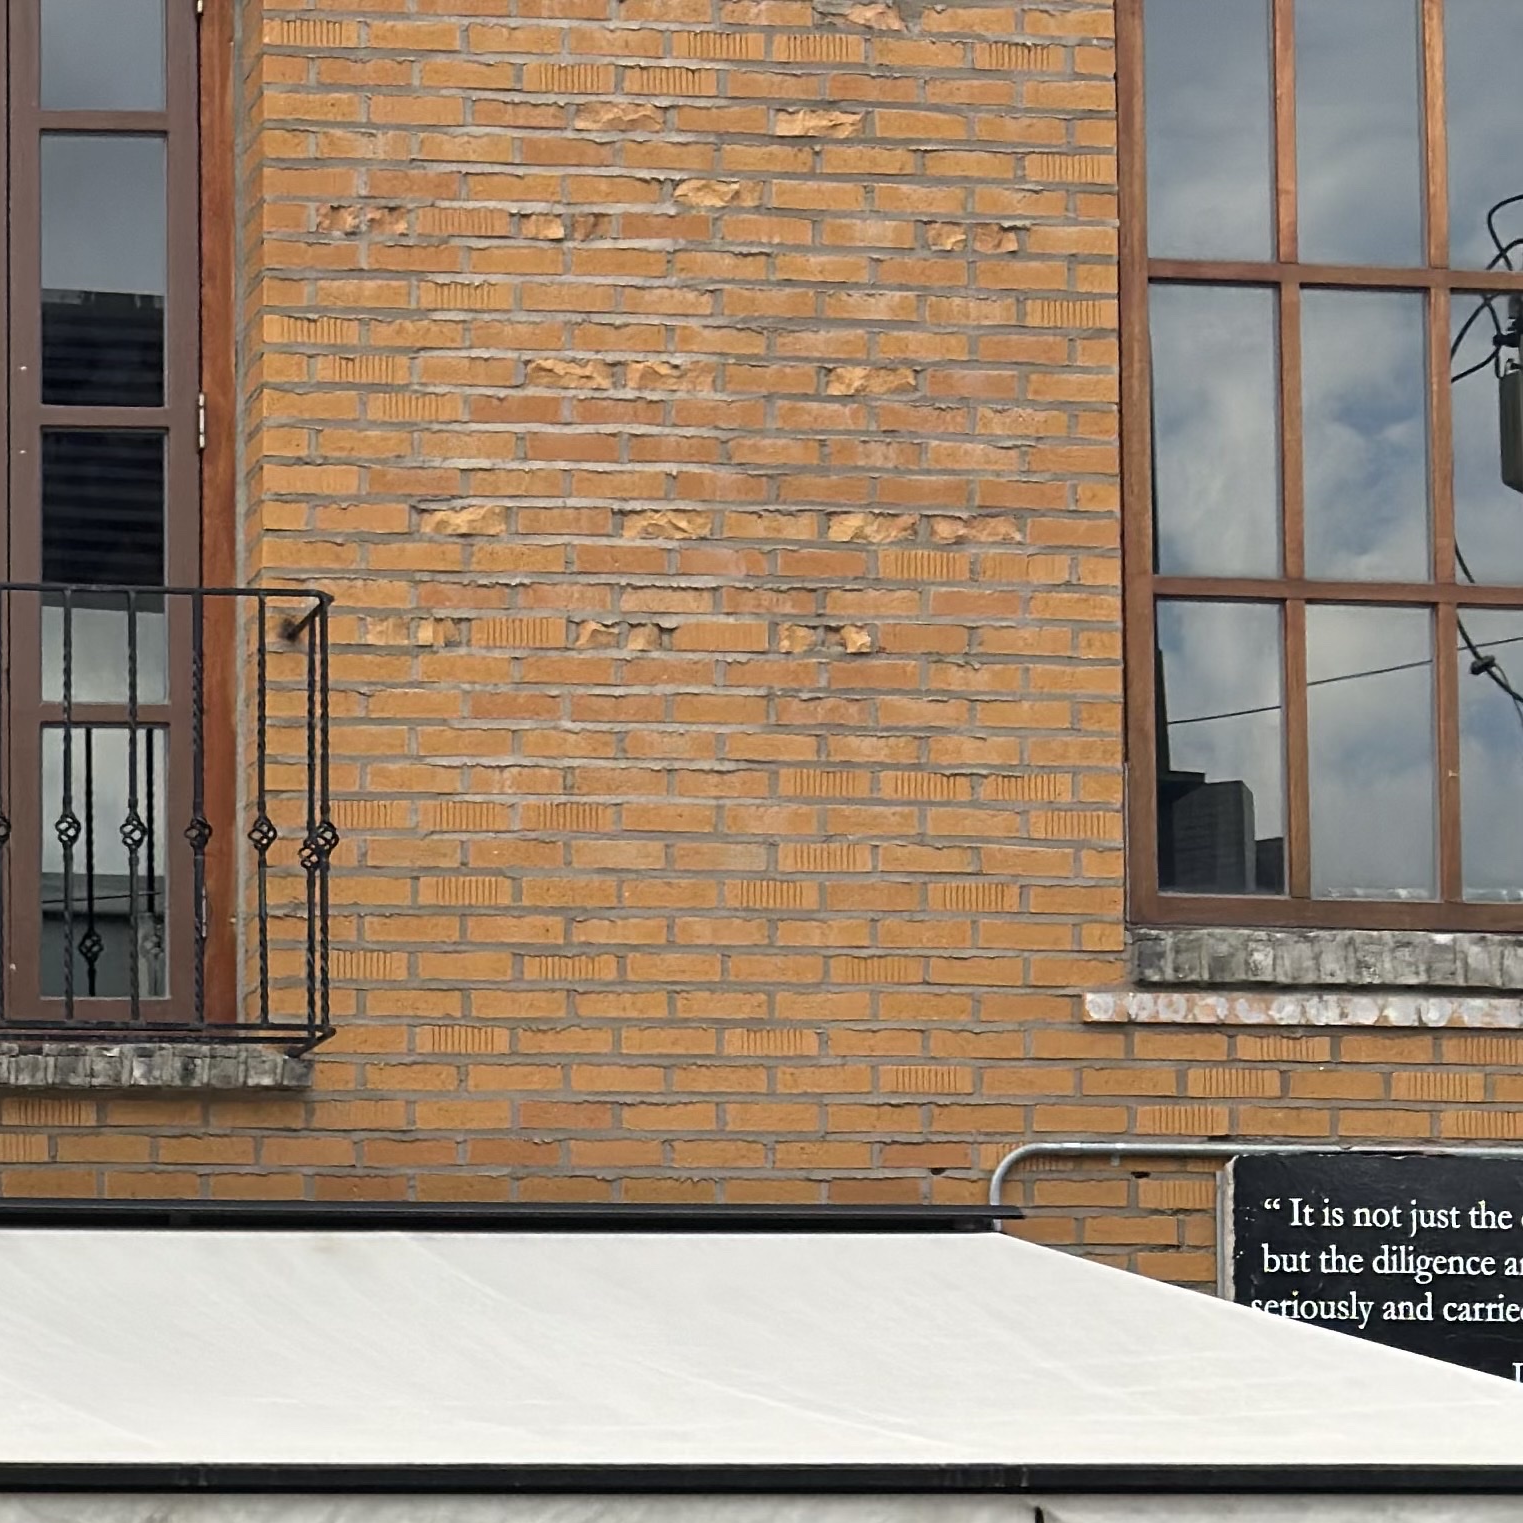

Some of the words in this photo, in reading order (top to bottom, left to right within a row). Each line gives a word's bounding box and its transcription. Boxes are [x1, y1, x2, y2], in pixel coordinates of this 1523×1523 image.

[1288, 1198, 1316, 1227] It
[1321, 1198, 1345, 1227] is
[1352, 1206, 1403, 1228] not
[1409, 1199, 1461, 1238] just
[1468, 1199, 1513, 1230] the
[1261, 1242, 1311, 1273] but
[1318, 1243, 1364, 1274] the
[1371, 1244, 1497, 1285] diligence
[1504, 1257, 1523, 1276] a
[1381, 1291, 1434, 1321] and
[1442, 1293, 1523, 1323] carrie
